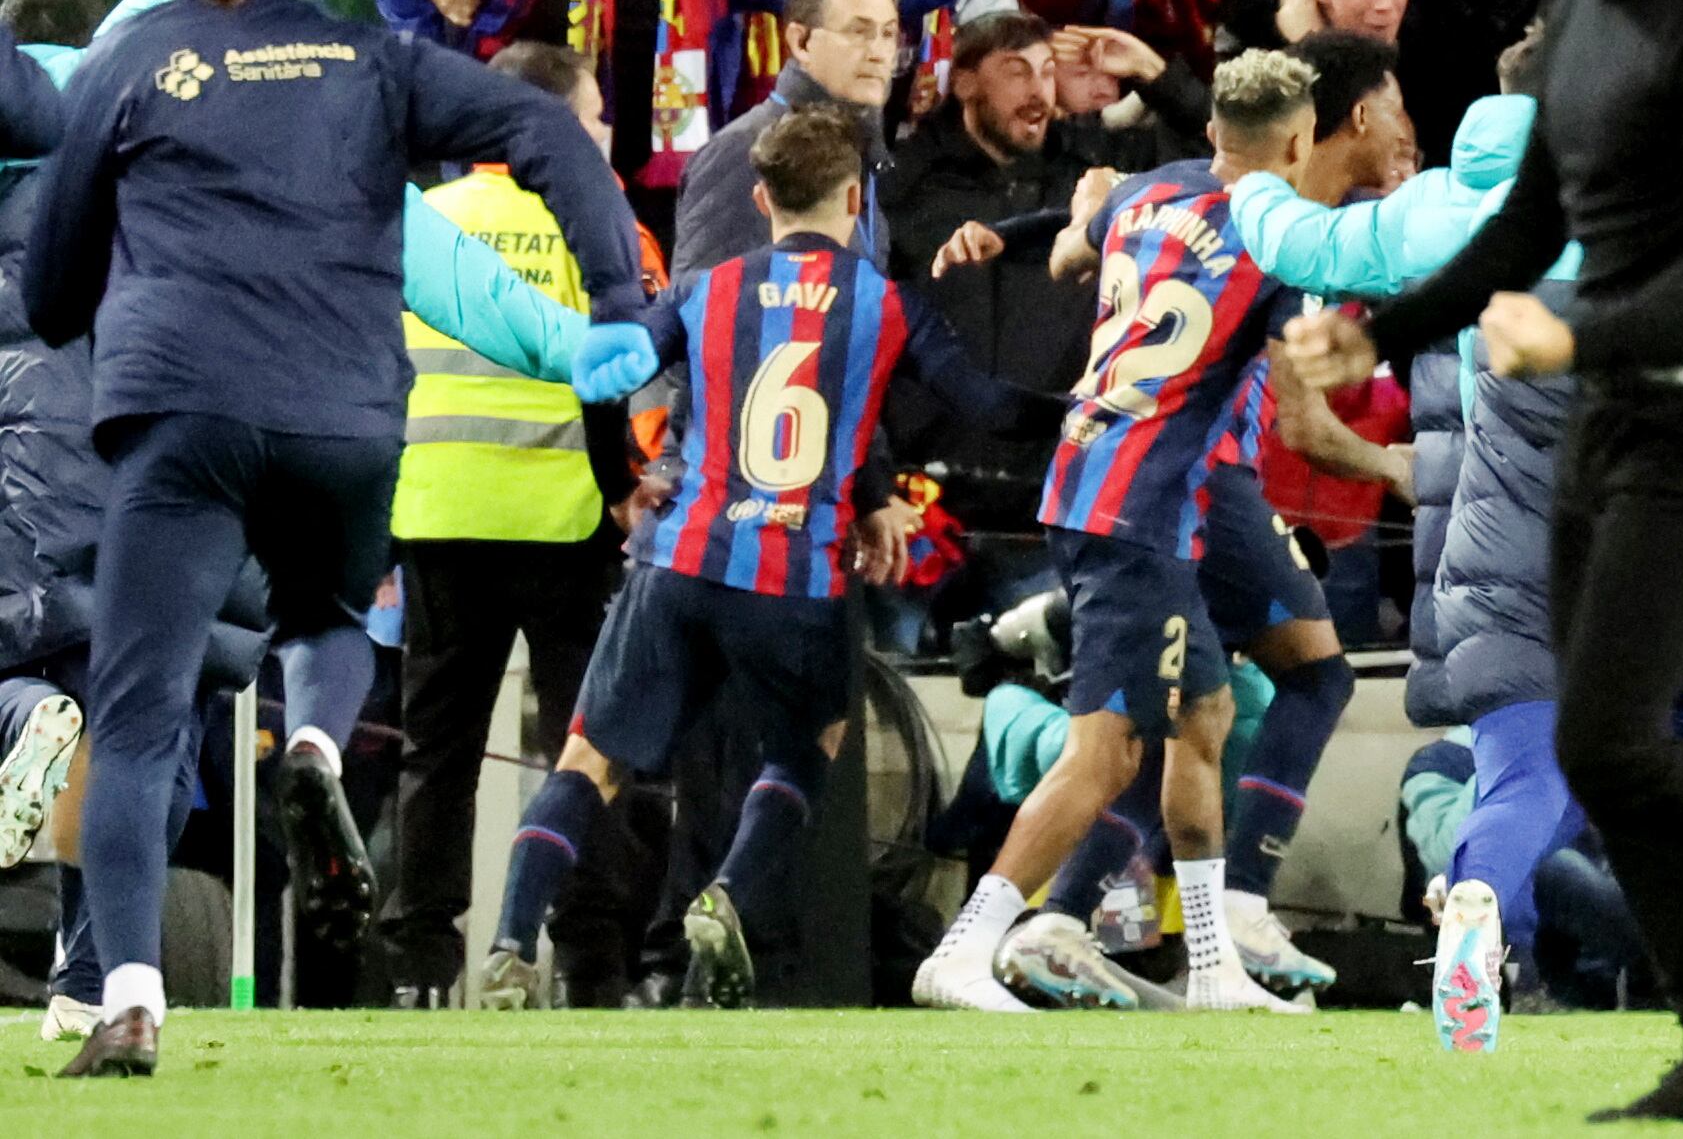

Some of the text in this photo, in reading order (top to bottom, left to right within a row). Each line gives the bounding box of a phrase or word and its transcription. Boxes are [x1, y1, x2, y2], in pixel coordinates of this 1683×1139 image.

[758, 281, 838, 313] GAVI
[1117, 203, 1238, 279] RAPHINHA
[1069, 251, 1213, 420] 22
[738, 340, 830, 492] 6
